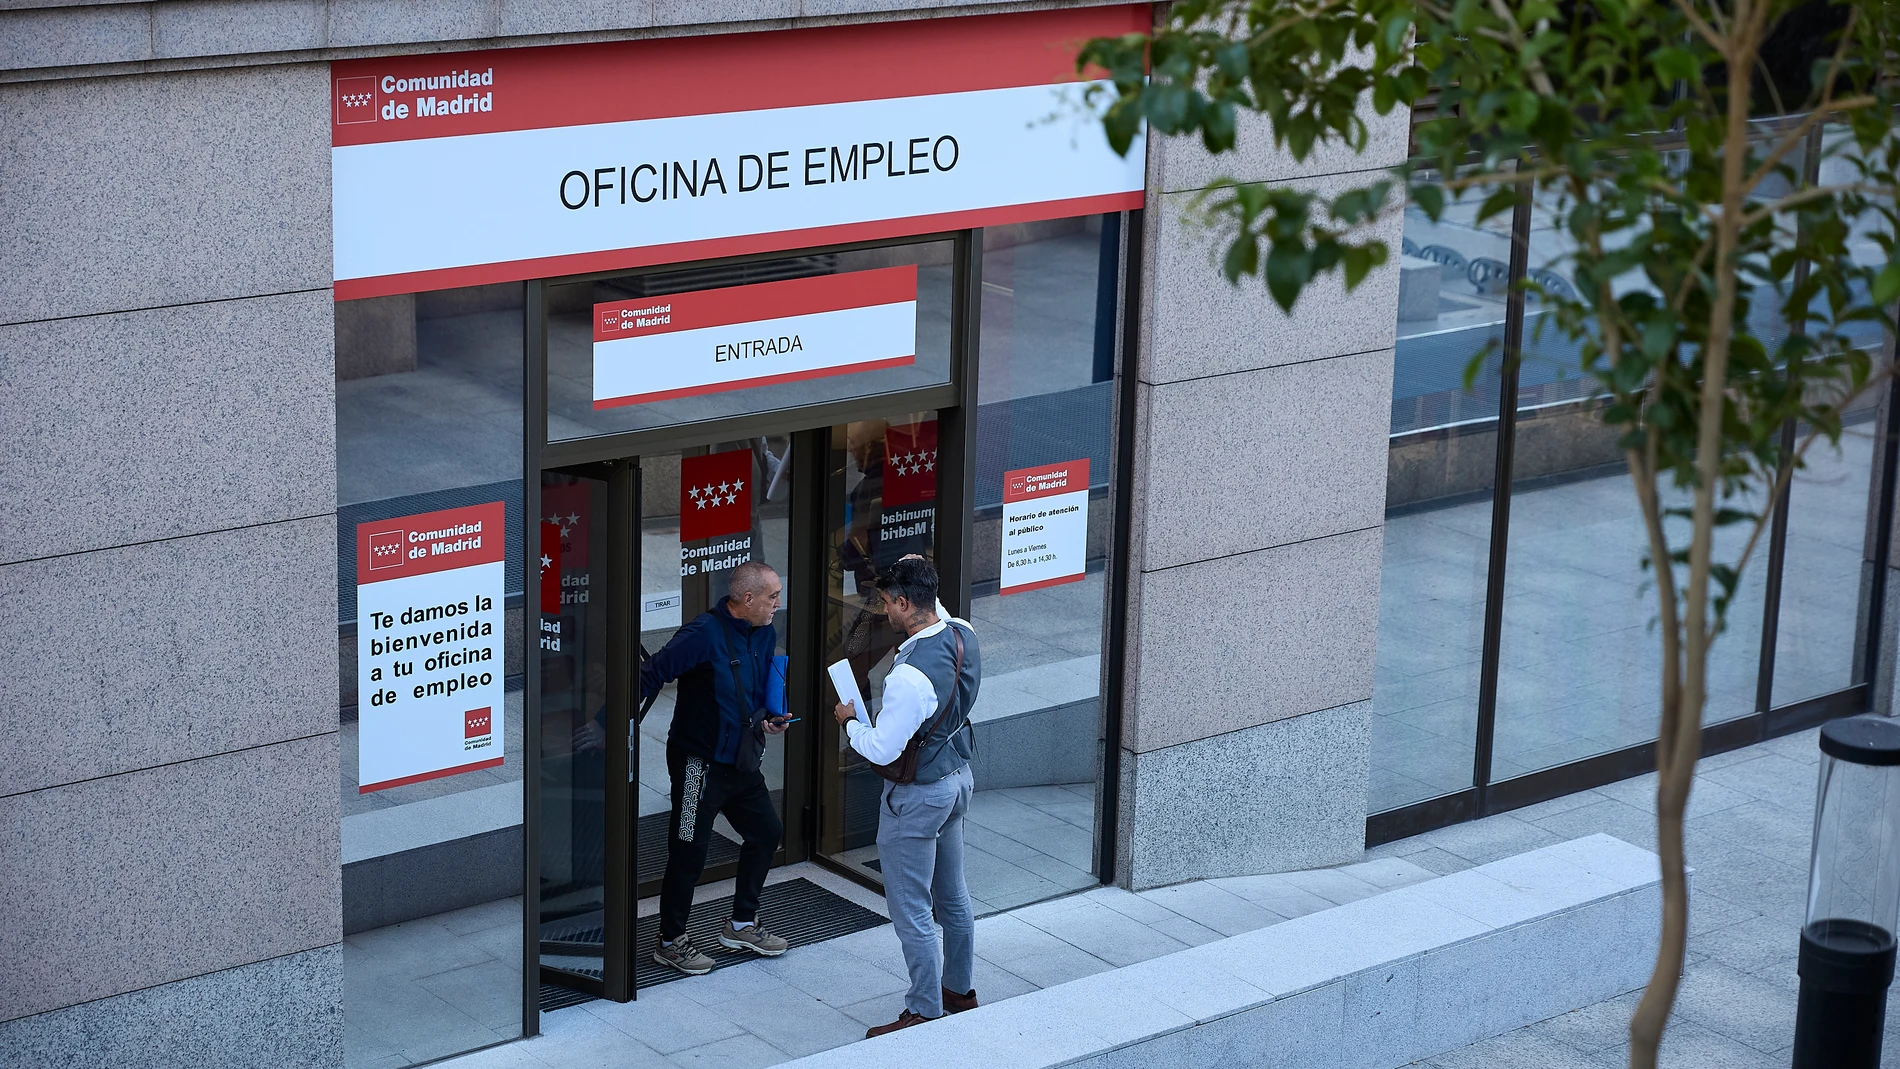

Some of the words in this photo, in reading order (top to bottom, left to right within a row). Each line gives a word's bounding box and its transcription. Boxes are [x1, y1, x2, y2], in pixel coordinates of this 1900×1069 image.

[381, 68, 493, 94] Comunidad
[381, 100, 409, 121] de
[417, 92, 493, 117] Madrid
[559, 158, 727, 210] OFICINA
[739, 151, 790, 193] DE
[804, 134, 960, 186] EMPLEO
[621, 304, 671, 318] Comunidad
[621, 320, 633, 329] de
[636, 315, 670, 328] Madrid
[715, 334, 803, 363] ENTRADA
[1026, 469, 1068, 483] Comunidad
[1026, 484, 1036, 492] de
[1039, 479, 1067, 490] Madrid
[1009, 512, 1036, 523] Horario
[1048, 505, 1079, 516] atención
[408, 521, 482, 543] Comunidad
[1017, 525, 1044, 536] público
[408, 546, 427, 559] de
[431, 536, 482, 556] Madrid
[680, 536, 751, 560] Comunidad
[1007, 548, 1023, 556] Lunes
[1028, 544, 1047, 552] Viernes
[680, 563, 697, 577] de
[701, 552, 751, 573] Madrid
[1007, 561, 1015, 569] De
[1015, 559, 1027, 567] 8,30
[1038, 554, 1052, 563] 14,30
[370, 612, 394, 631] Te
[400, 600, 469, 626] damos
[475, 595, 493, 612] la
[654, 600, 671, 608] TIRAR
[371, 620, 493, 656] bienvenida
[370, 668, 382, 682] a
[393, 660, 413, 678] tu
[424, 647, 493, 672] oficina
[371, 689, 397, 707] de
[413, 672, 493, 699] empleo
[464, 736, 491, 746] Comunidad
[473, 741, 491, 749] Madrid
